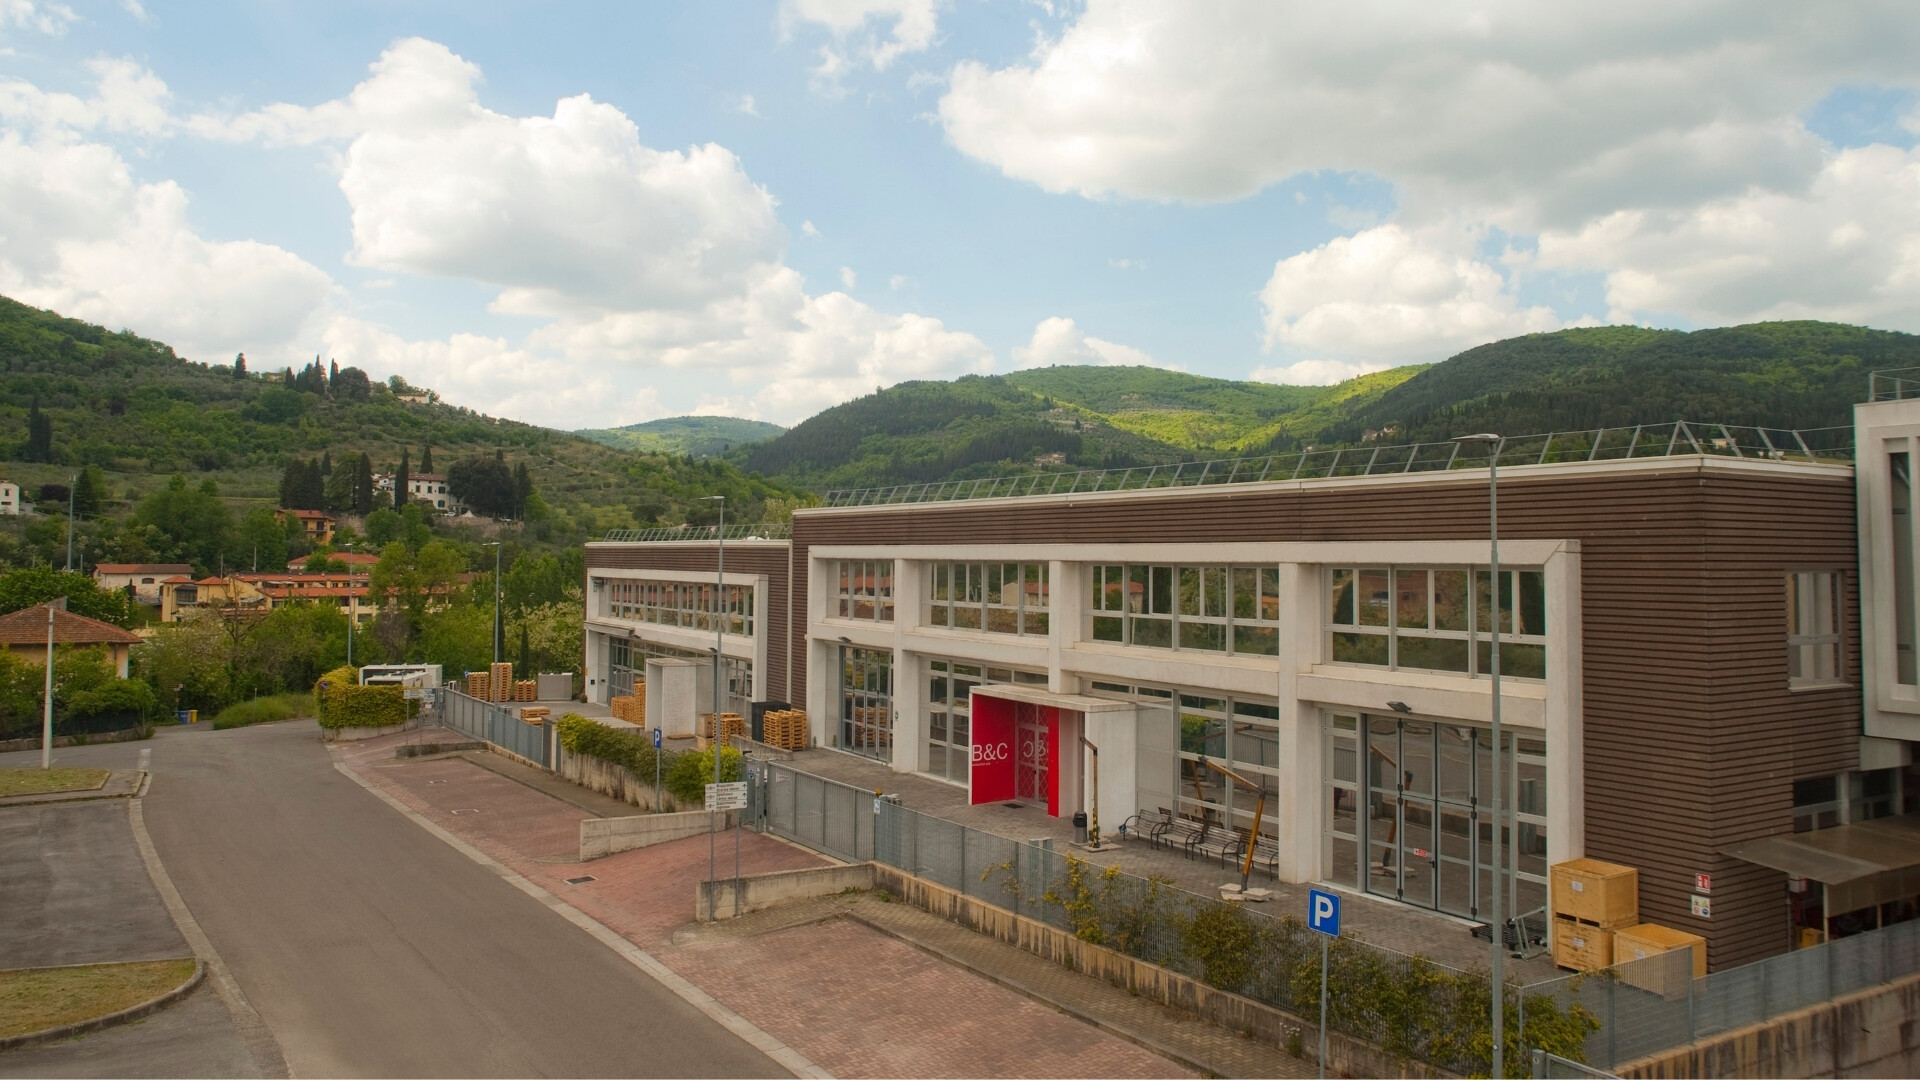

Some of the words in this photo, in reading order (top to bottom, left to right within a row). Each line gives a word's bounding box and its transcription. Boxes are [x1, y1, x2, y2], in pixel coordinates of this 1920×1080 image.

[655, 730, 660, 747] P
[972, 742, 1008, 762] B&C
[1315, 894, 1333, 927] P
